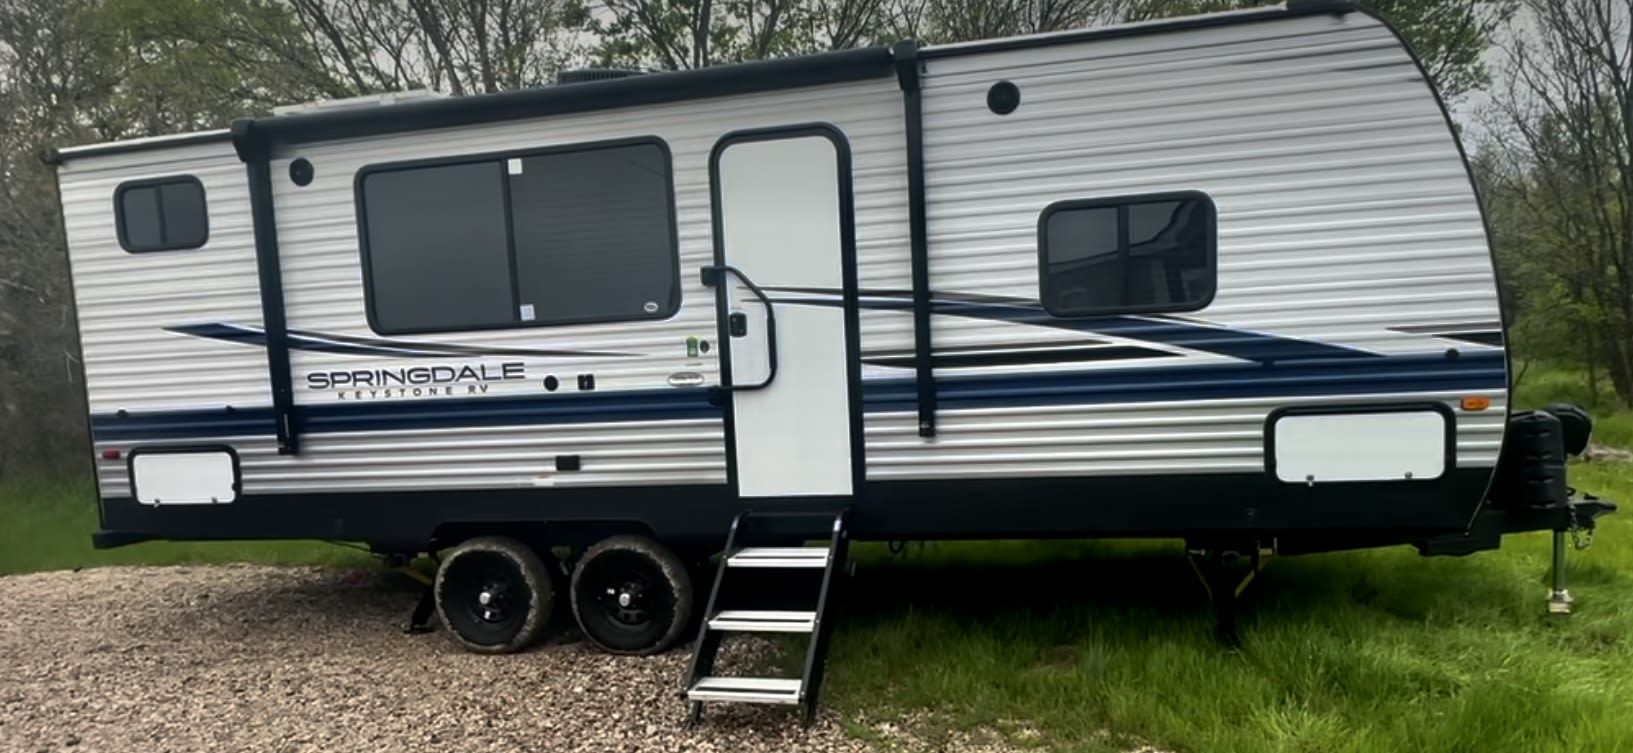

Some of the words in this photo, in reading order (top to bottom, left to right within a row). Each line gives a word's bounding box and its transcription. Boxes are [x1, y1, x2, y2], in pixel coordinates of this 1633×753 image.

[307, 362, 525, 390] SPRINGDALE
[338, 387, 453, 400] KEYSTONE
[468, 384, 489, 394] RV
